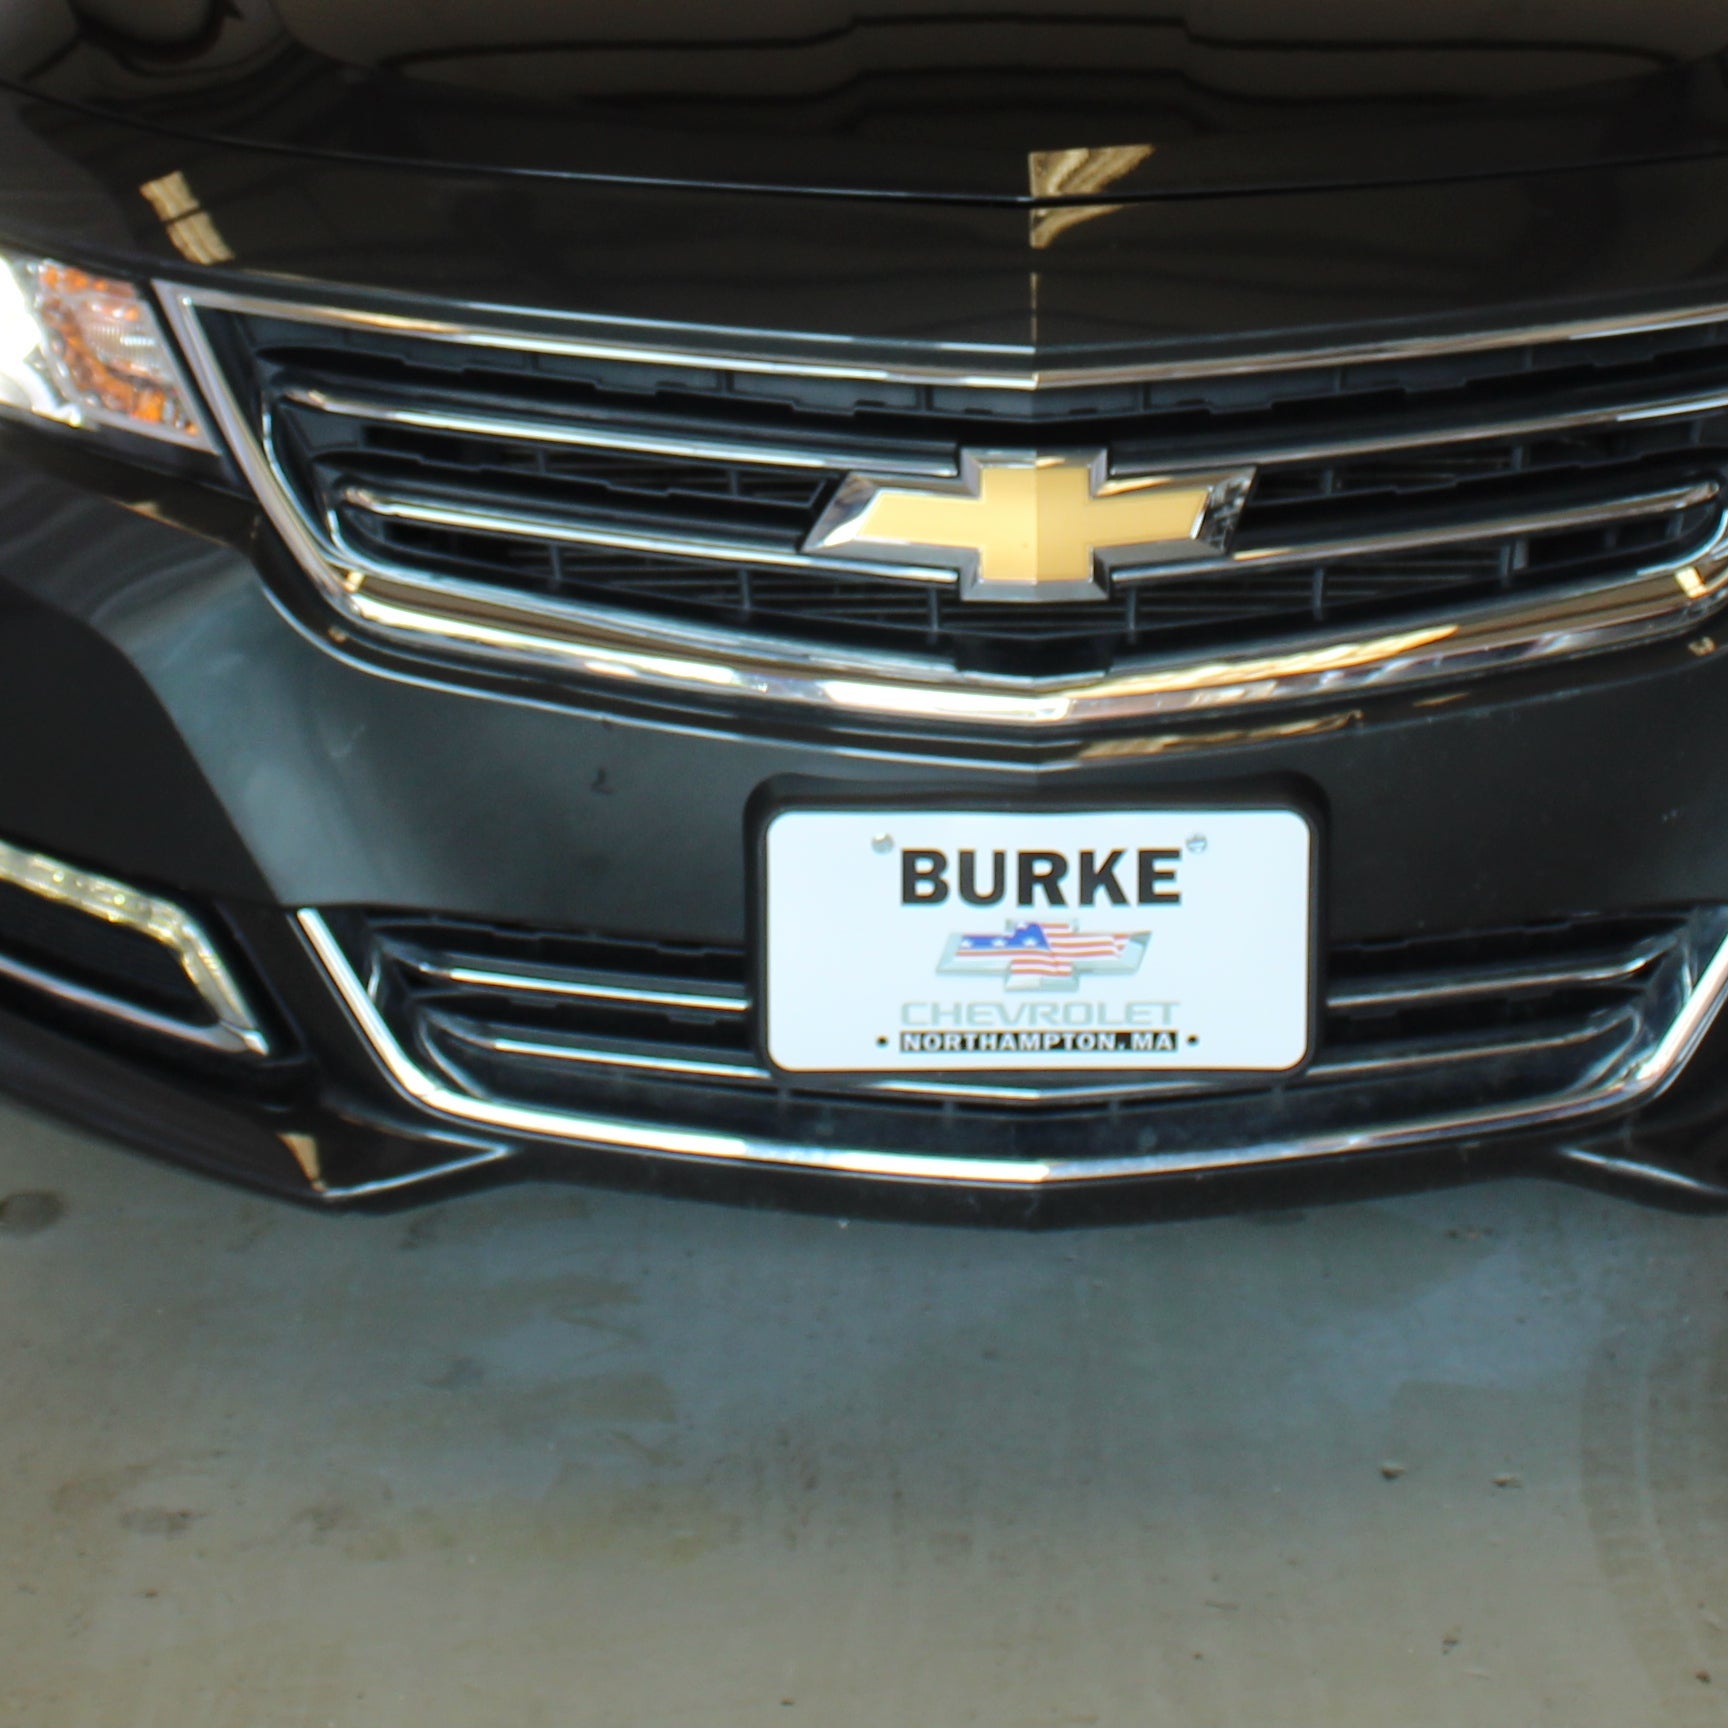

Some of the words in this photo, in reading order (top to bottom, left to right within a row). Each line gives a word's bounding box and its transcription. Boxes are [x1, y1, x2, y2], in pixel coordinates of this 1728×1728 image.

[900, 848, 1182, 907] BURKE
[901, 1002, 1182, 1027] CHEVROLET
[1130, 1032, 1176, 1053] MA
